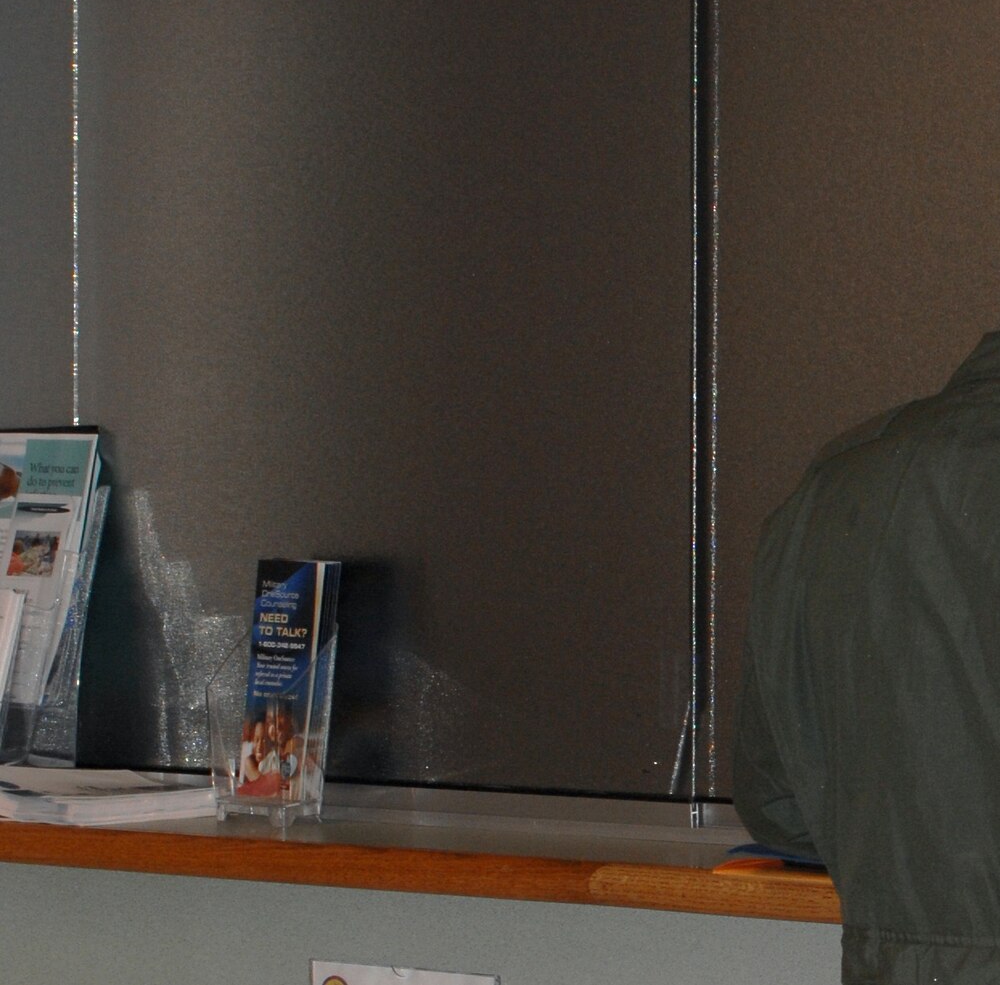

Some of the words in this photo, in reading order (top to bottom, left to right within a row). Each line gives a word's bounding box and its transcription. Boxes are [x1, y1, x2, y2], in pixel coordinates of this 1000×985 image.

[30, 462, 50, 473] What
[50, 465, 65, 476] you
[66, 466, 79, 474] can
[26, 475, 37, 486] do
[39, 478, 46, 486] to
[47, 479, 75, 490] prevent
[259, 613, 289, 624] NEED
[259, 626, 273, 636] TO
[277, 627, 308, 637] TALK?
